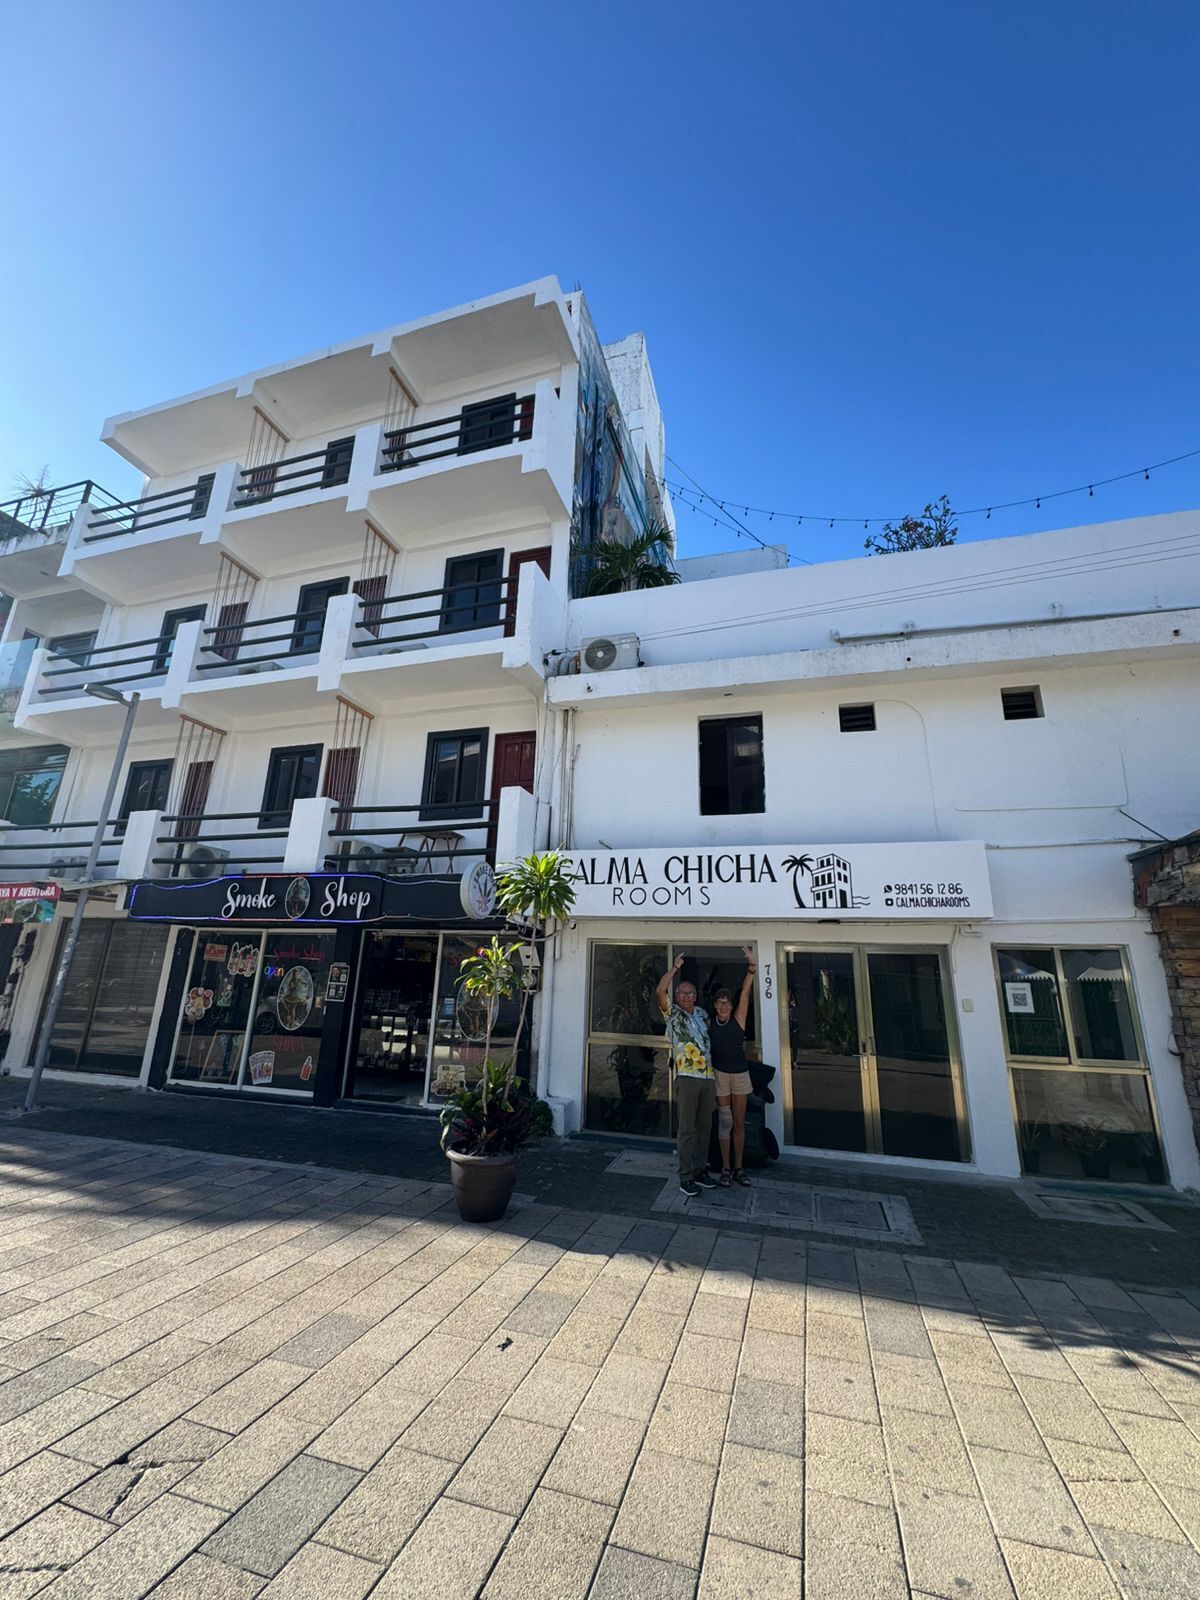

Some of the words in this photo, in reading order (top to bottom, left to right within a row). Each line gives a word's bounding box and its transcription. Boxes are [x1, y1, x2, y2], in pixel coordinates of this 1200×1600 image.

[664, 854, 778, 884] CHICHA
[11, 887, 18, 897] Y
[18, 886, 55, 897] AVENTURA
[221, 877, 277, 918] Smoke
[320, 876, 371, 919] Shop
[613, 886, 711, 906] ROOMS
[896, 896, 970, 908] CALMACHICHAROOMS
[764, 964, 773, 999] 796
